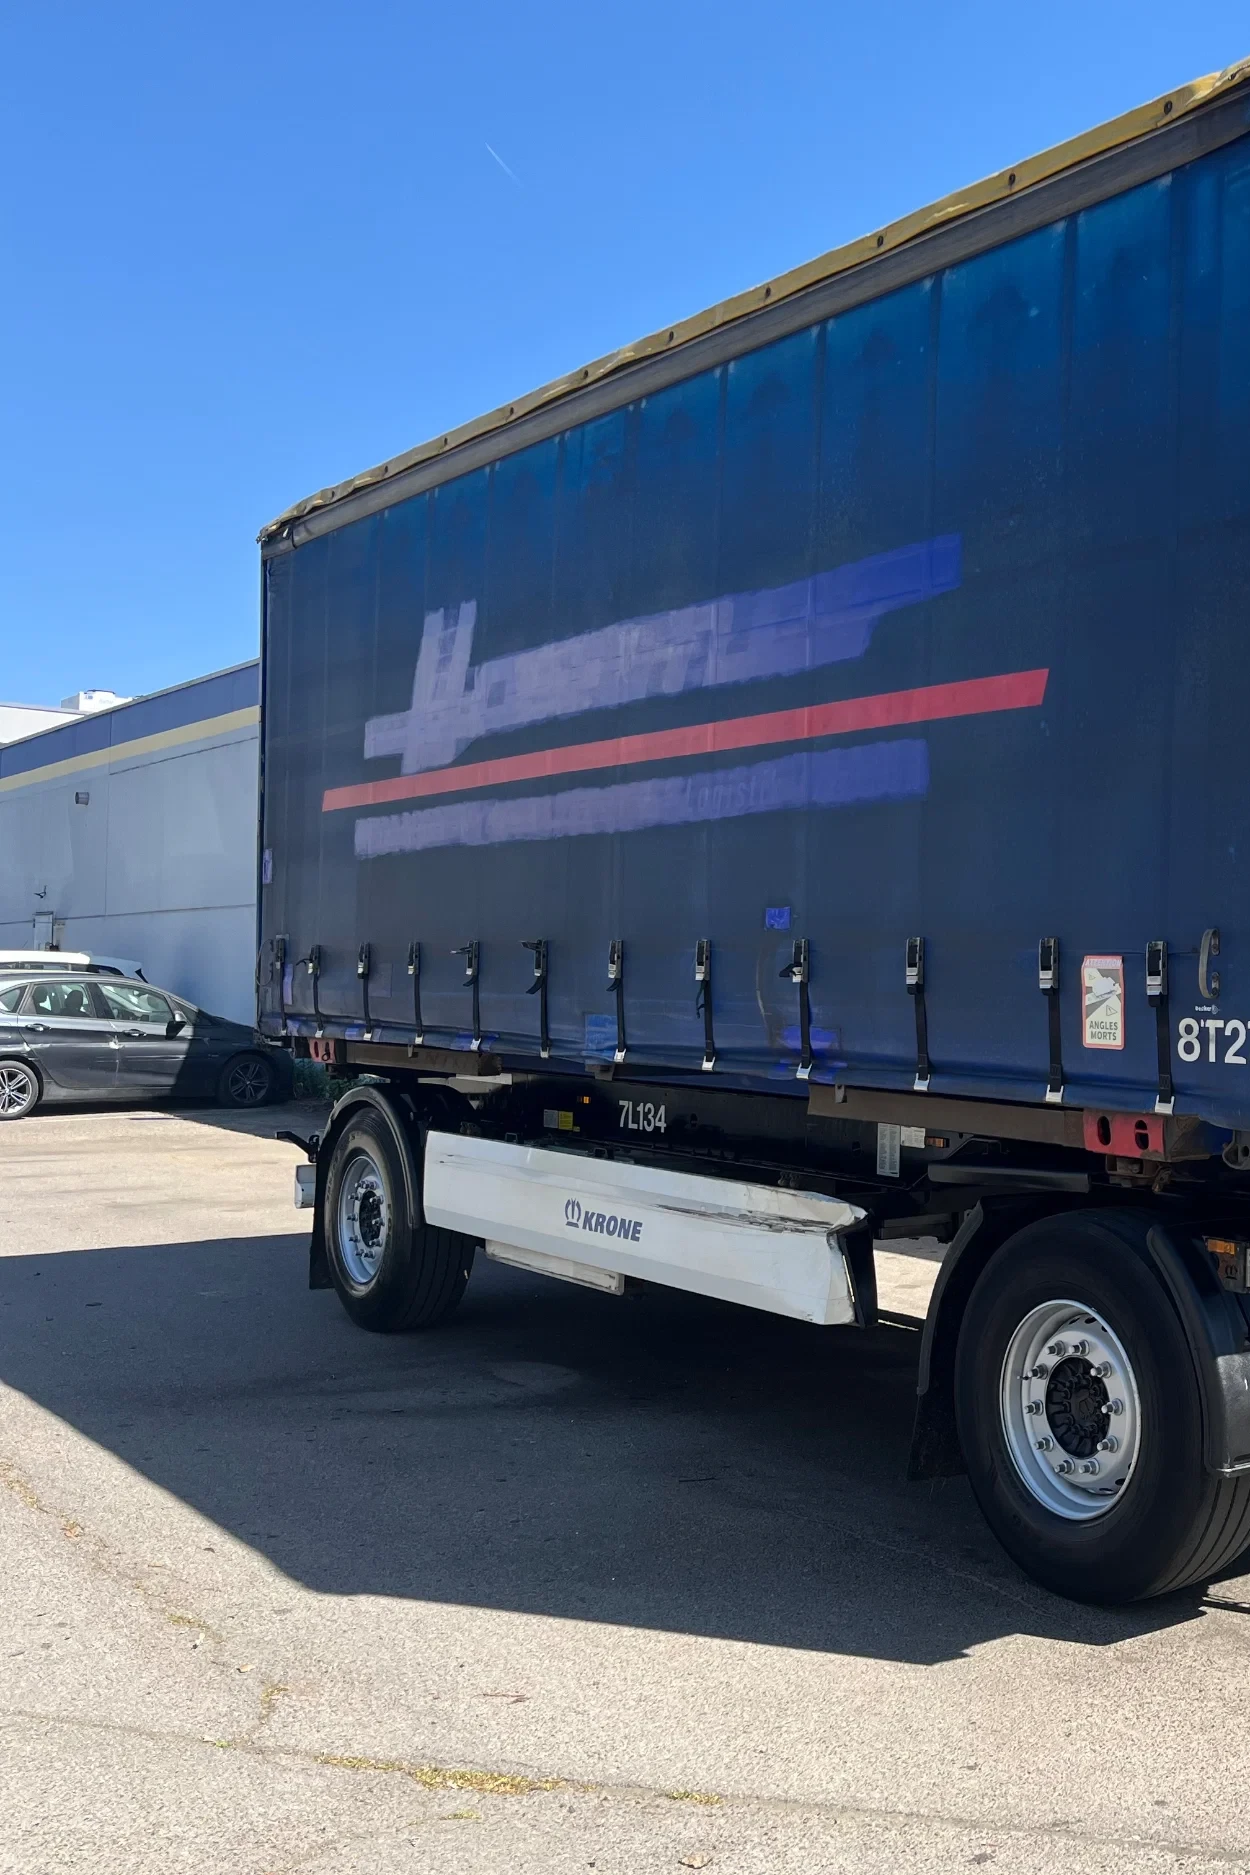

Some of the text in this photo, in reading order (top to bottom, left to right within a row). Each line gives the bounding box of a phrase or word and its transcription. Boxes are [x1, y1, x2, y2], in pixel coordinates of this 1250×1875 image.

[1089, 1020, 1119, 1031] ANGLES
[1090, 1031, 1117, 1041] MORTS
[618, 1100, 667, 1133] 7L134
[582, 1210, 643, 1242] KRONE
